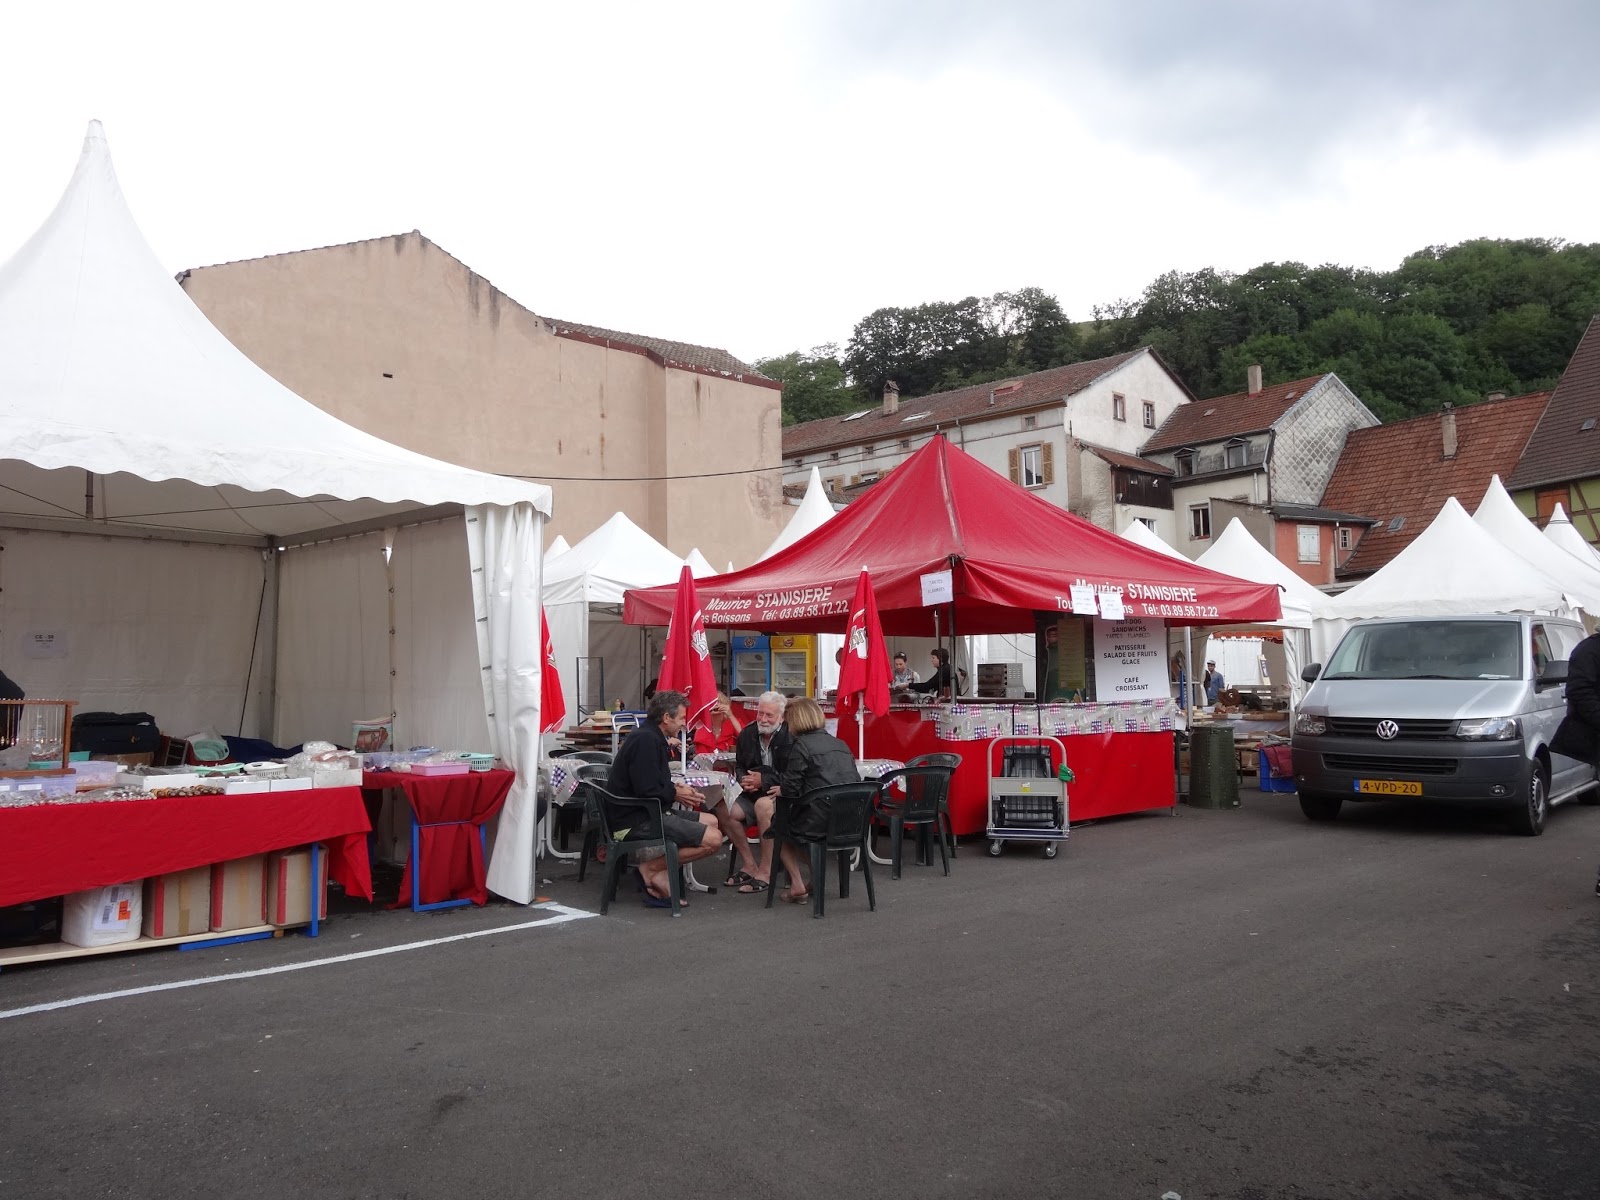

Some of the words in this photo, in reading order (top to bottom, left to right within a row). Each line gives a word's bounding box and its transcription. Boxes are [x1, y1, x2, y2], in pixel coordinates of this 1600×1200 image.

[705, 596, 752, 611] Maurice
[755, 586, 833, 609] STANISIERE
[1129, 583, 1198, 602] STANISIERE
[711, 611, 751, 623] Boissons
[779, 599, 849, 620] 03.89.58.72.22
[1161, 604, 1219, 617] 03.89.58.72.22
[1363, 781, 1418, 794] 4-VPD-20
